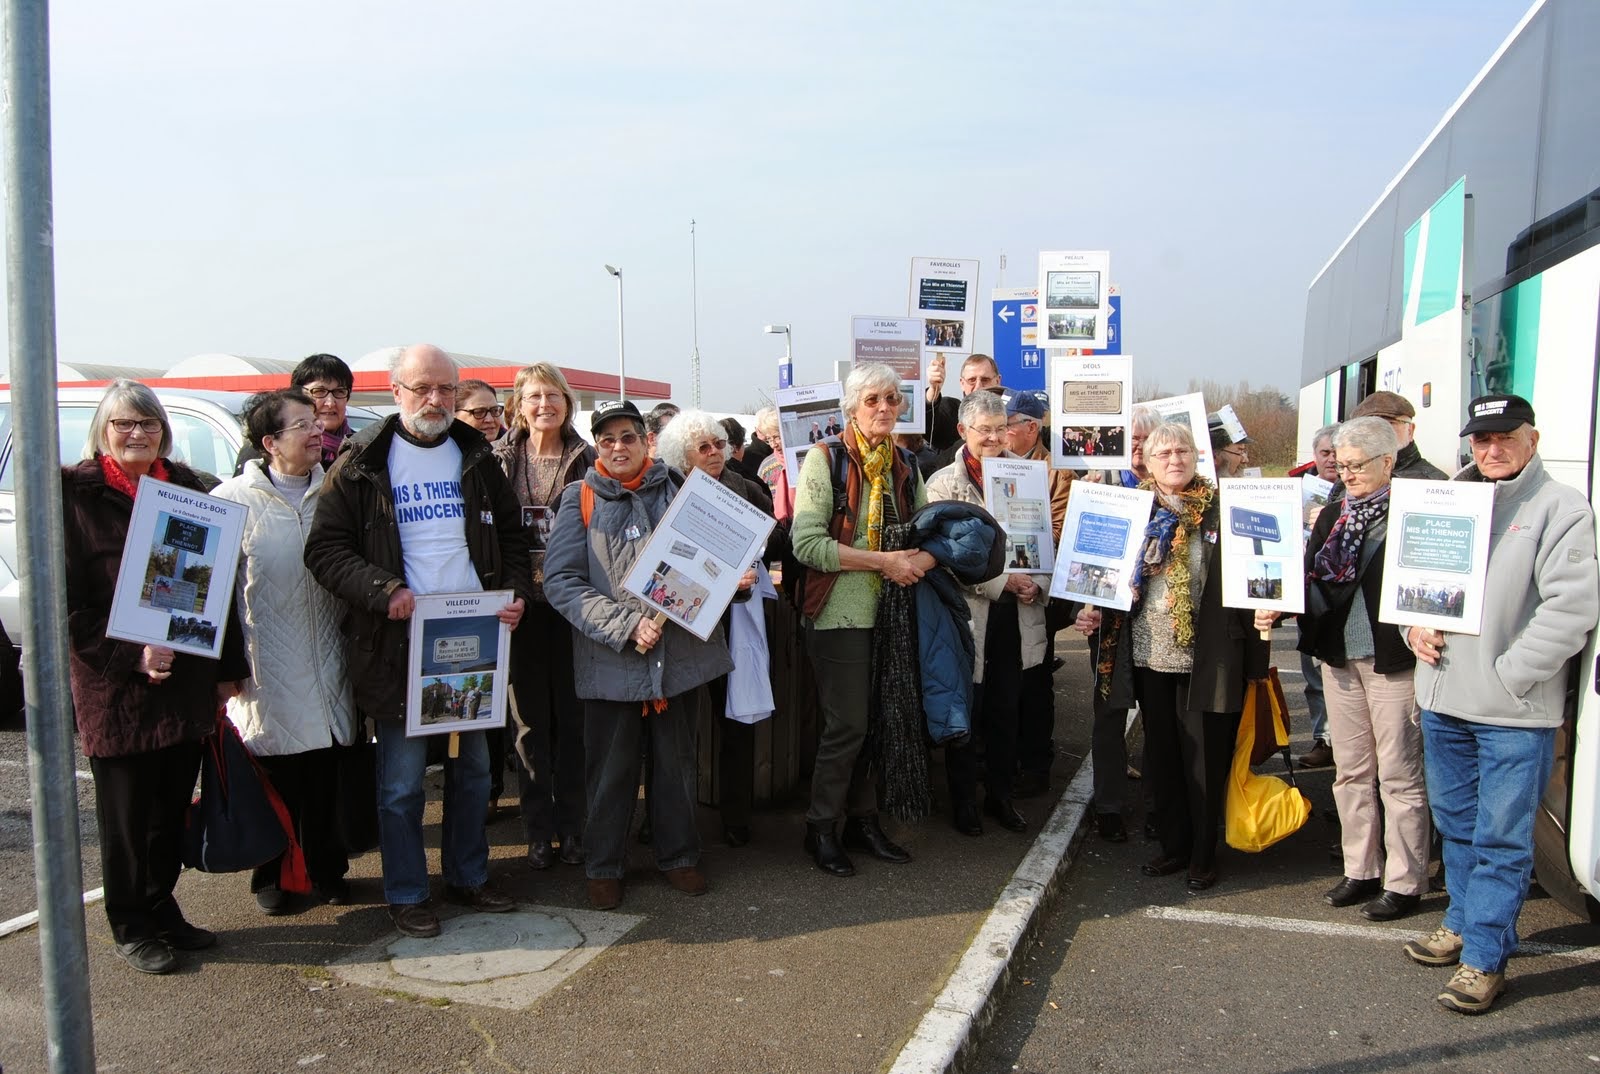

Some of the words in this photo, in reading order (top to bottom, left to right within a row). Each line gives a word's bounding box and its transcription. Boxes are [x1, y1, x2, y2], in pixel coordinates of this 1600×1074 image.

[414, 483, 422, 502] &
[701, 474, 768, 522] SAINT-GEORGES-SUR-ARNON
[158, 490, 228, 515] NEUILLAY-LES-BOIS
[398, 504, 467, 524] INNOCENT
[180, 522, 198, 532] PLACE
[1426, 520, 1451, 528] PLACE
[1430, 528, 1470, 538] THIENNOT
[172, 538, 198, 550] THIENNOT
